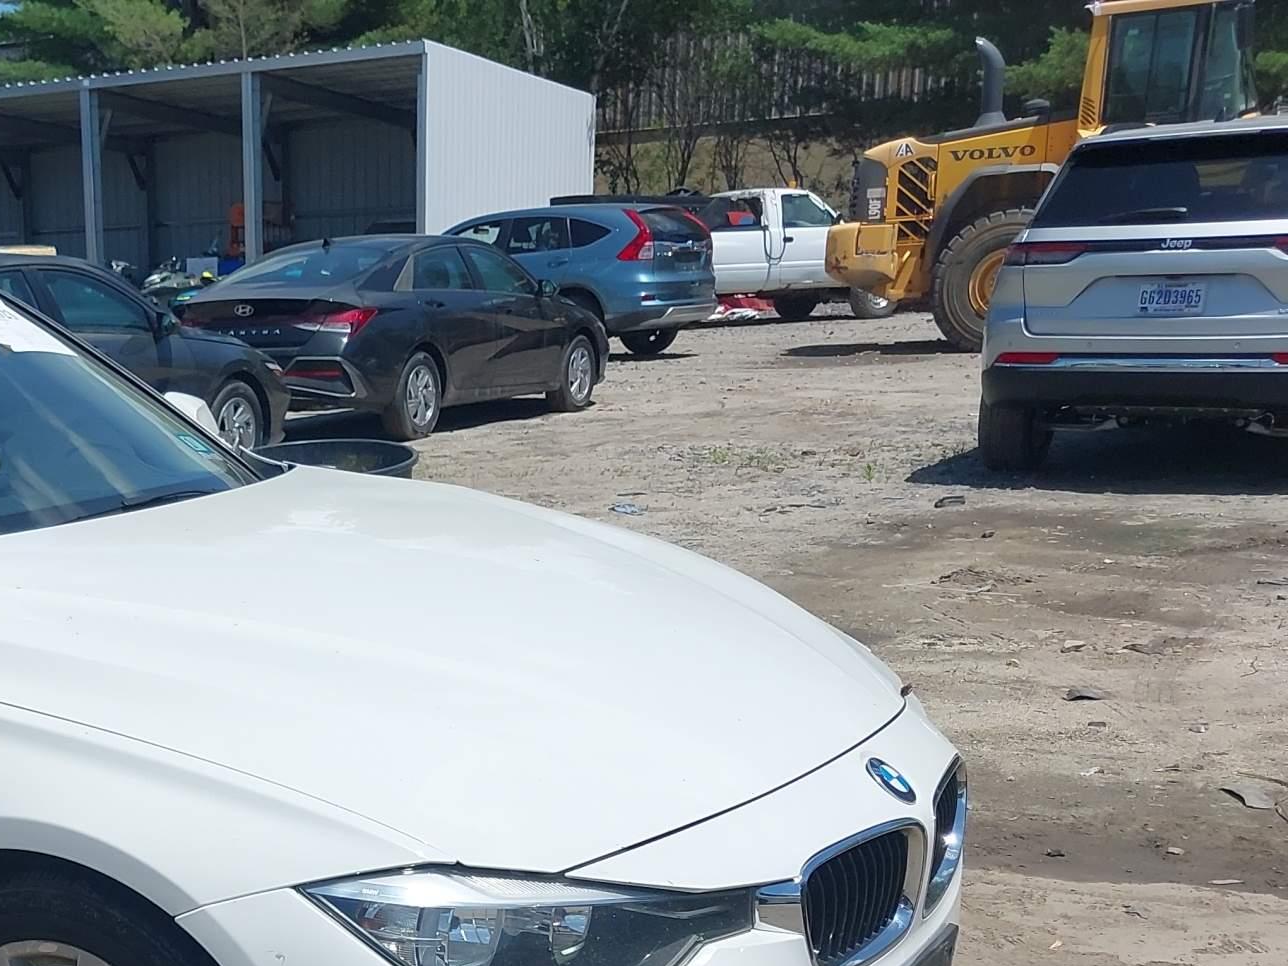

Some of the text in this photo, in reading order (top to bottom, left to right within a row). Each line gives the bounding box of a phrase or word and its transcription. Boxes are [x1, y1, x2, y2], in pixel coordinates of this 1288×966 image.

[949, 145, 1036, 161] VOLVO
[868, 198, 881, 219] L90F
[1161, 239, 1192, 249] Jeep
